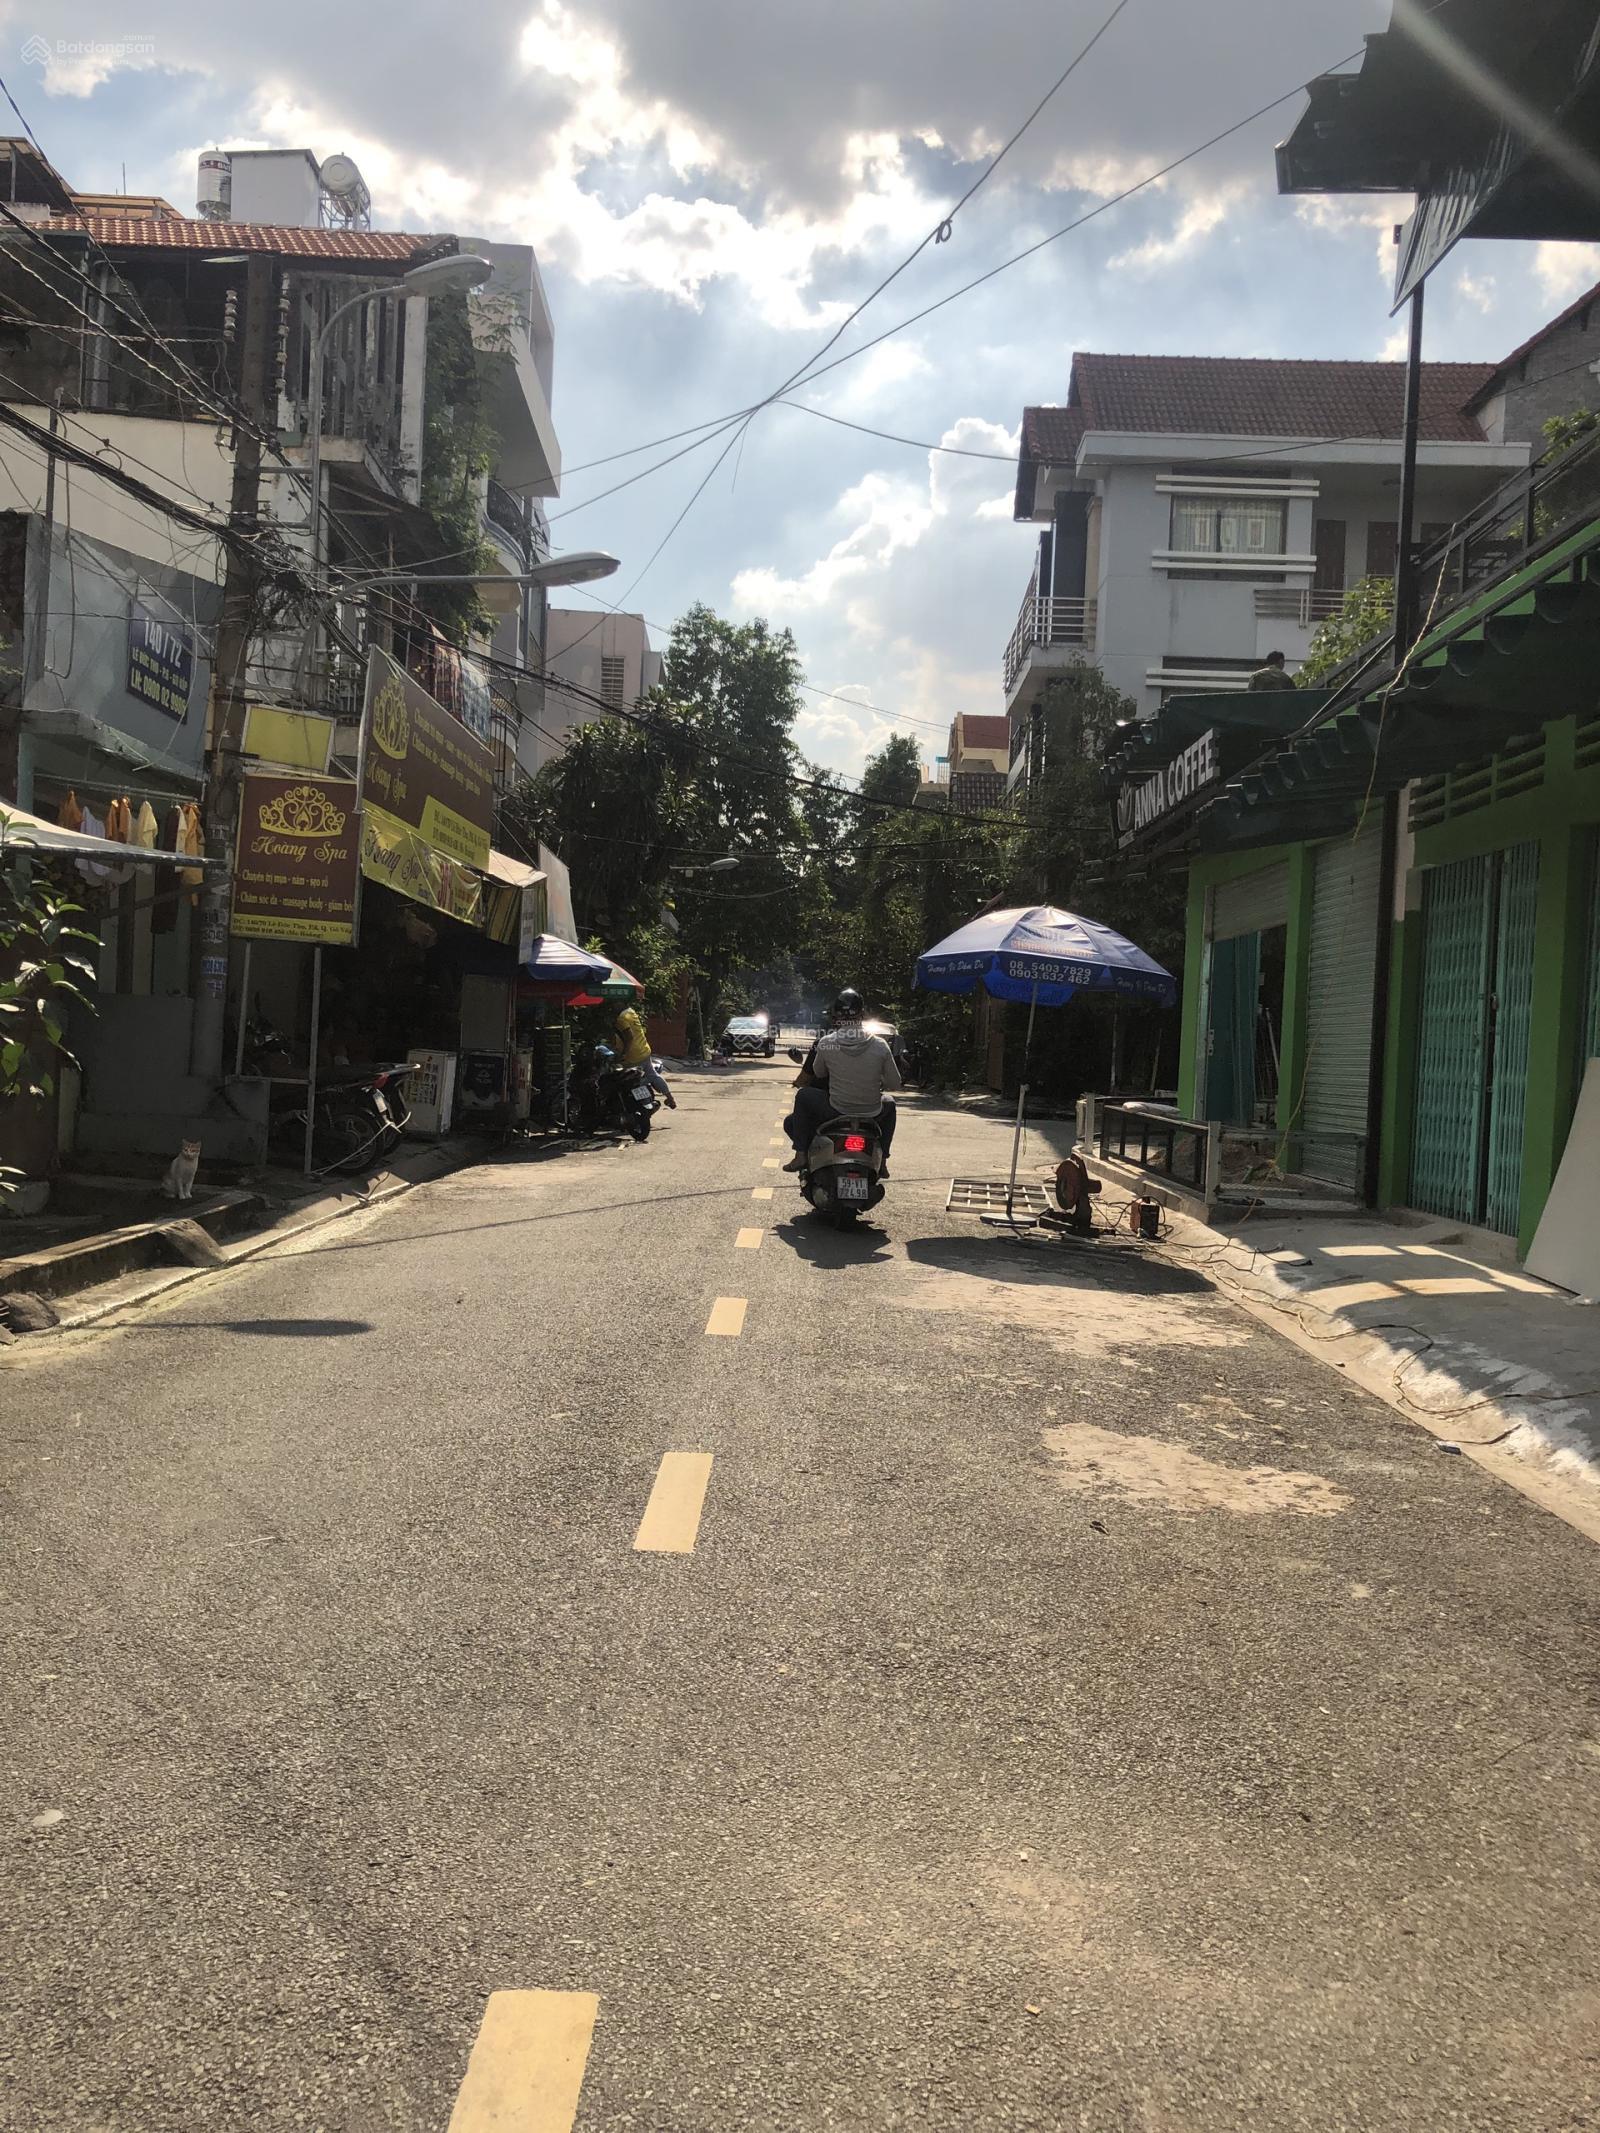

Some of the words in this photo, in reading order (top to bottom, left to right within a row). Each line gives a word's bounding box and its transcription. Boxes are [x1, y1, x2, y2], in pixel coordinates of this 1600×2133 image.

[1134, 769, 1165, 831] ANNA
[1167, 727, 1215, 807] COFFEE
[251, 836, 308, 863] Hoàng
[313, 841, 348, 865] Spa
[1009, 968, 1064, 982] 0903.632
[1067, 975, 1090, 985] 462
[1031, 962, 1059, 973] 5403
[1062, 965, 1092, 977] 7829
